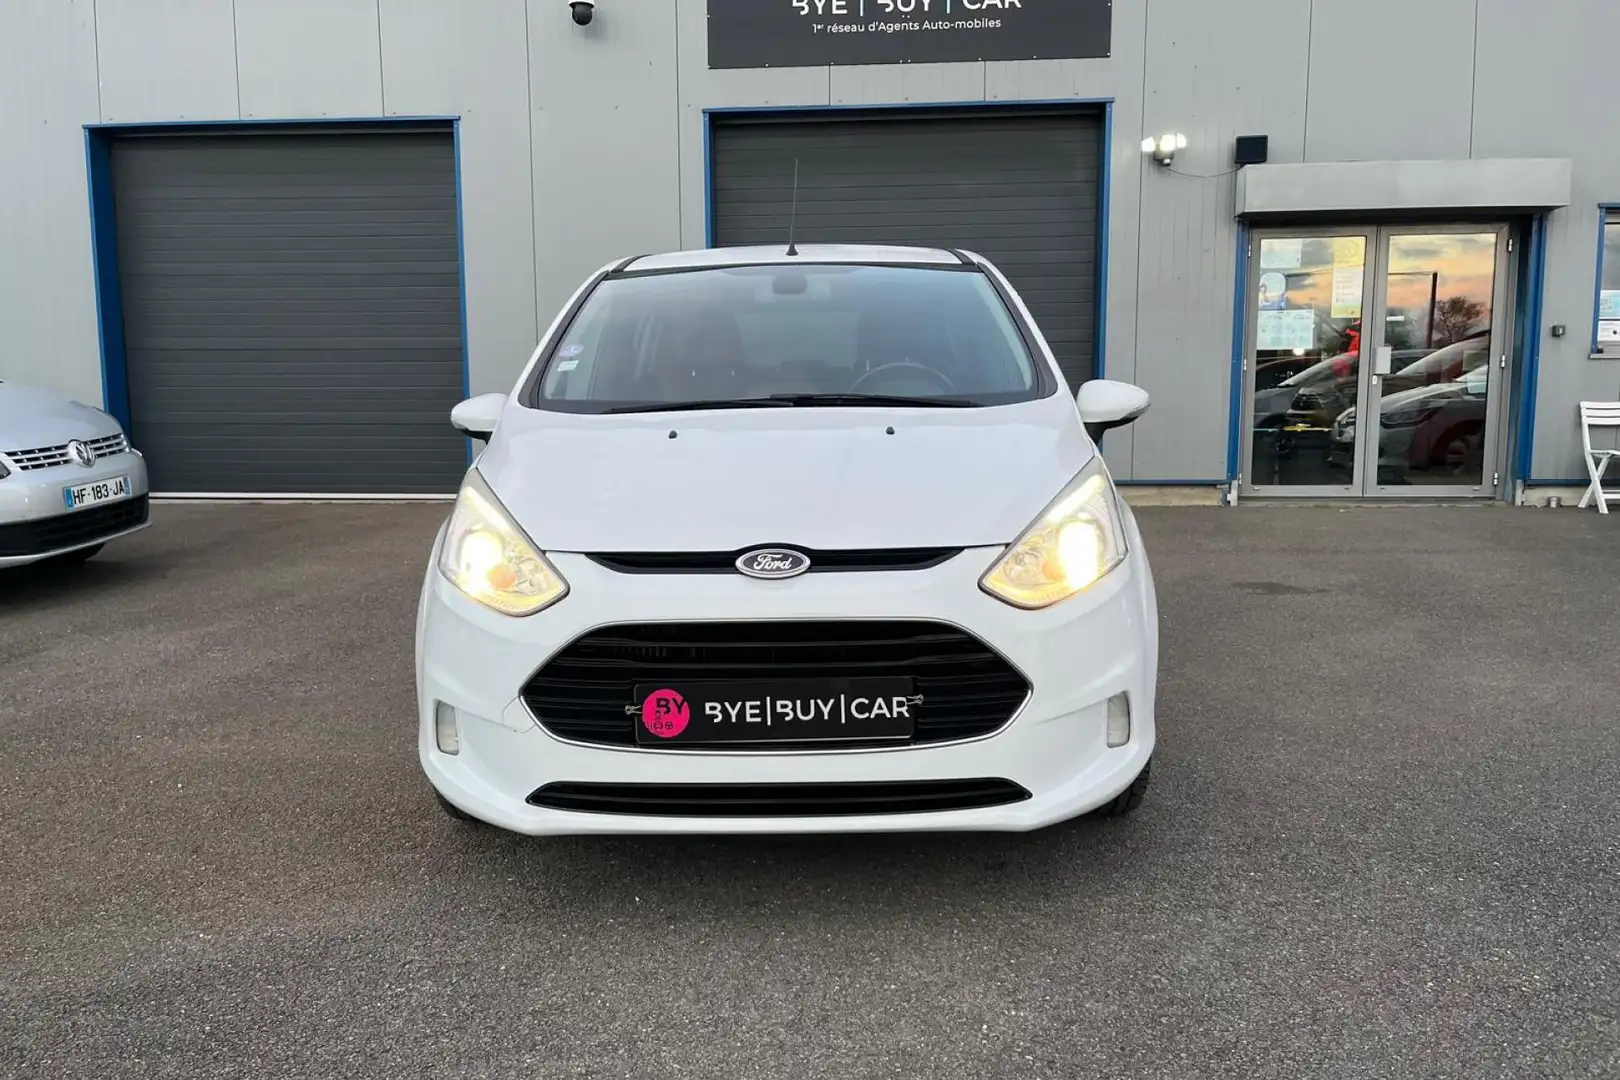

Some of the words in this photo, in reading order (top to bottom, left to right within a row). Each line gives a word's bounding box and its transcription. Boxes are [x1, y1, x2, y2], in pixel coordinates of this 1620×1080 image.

[827, 23, 865, 33] réseau
[868, 21, 920, 33] d'Agents
[922, 18, 1002, 31] Auto-mobiles
[753, 553, 793, 570] Ford
